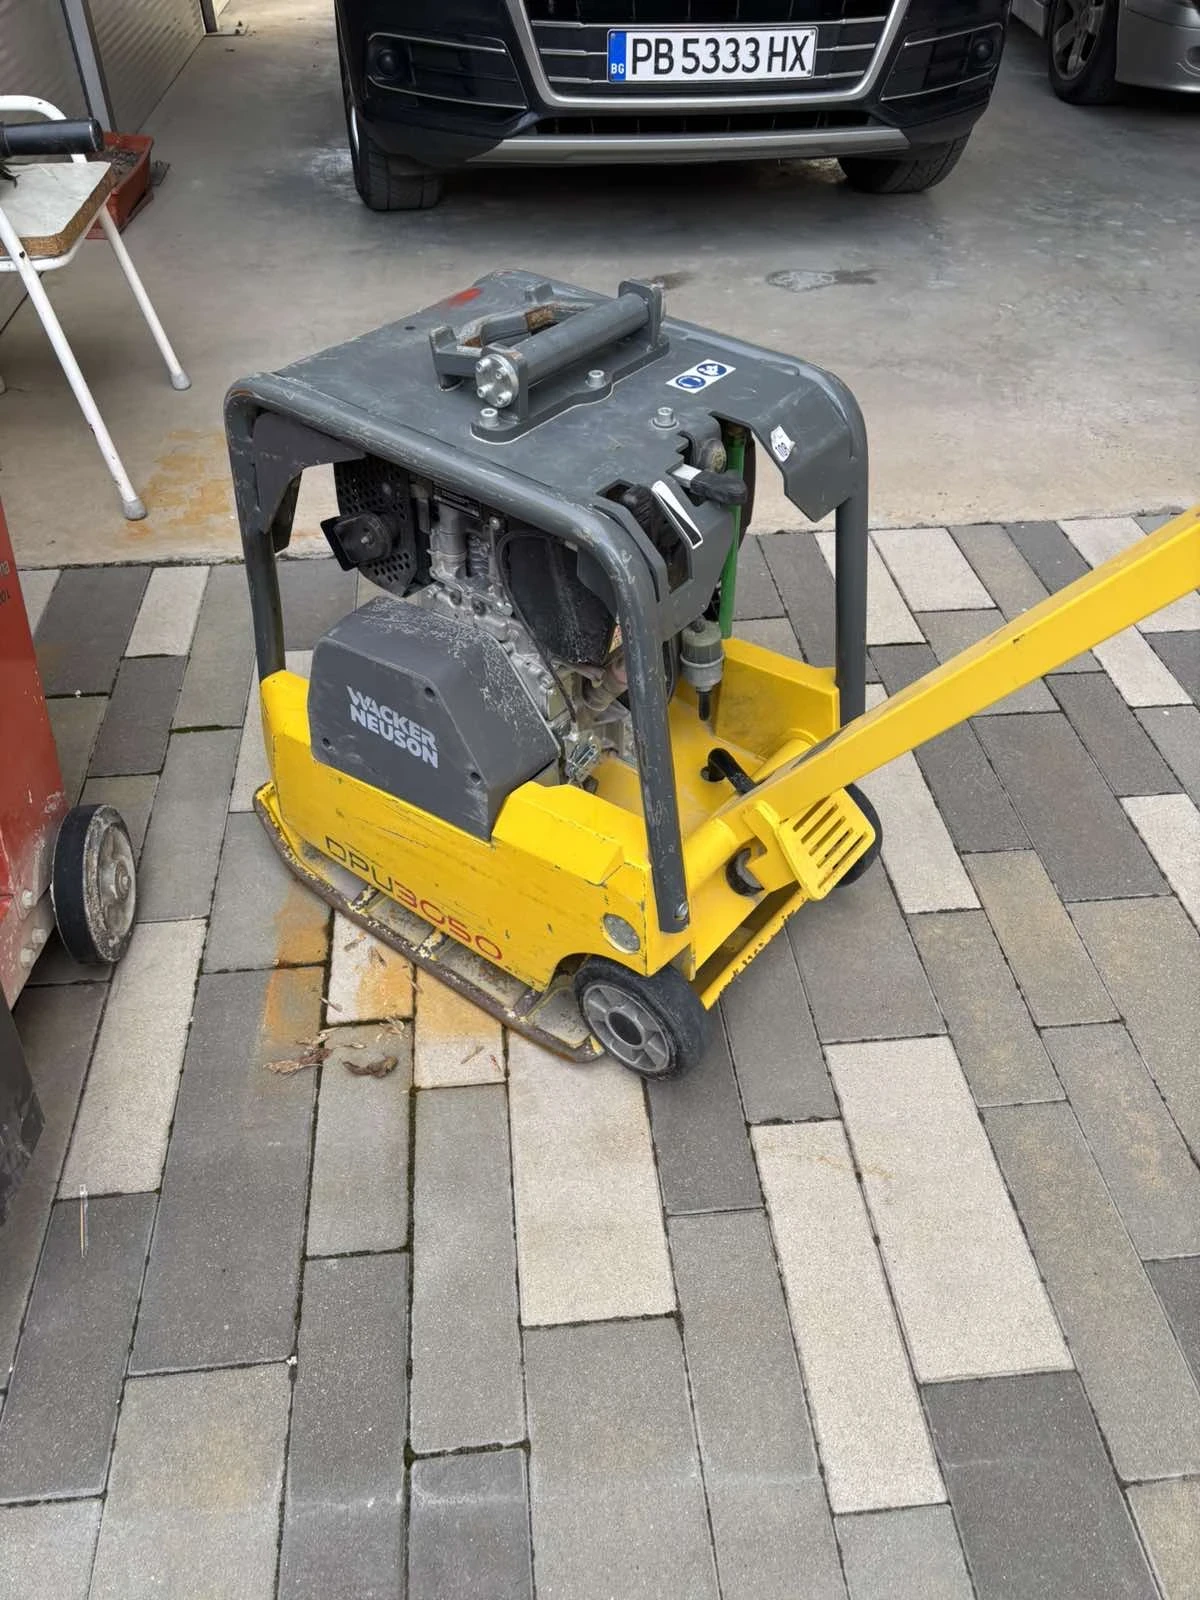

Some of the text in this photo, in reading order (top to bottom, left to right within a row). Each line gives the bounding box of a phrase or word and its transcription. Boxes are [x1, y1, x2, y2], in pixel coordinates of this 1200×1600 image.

[610, 63, 625, 75] BG
[631, 35, 809, 75] PB 5333 HX
[347, 685, 438, 750] WACKER
[350, 704, 439, 769] NEUSON
